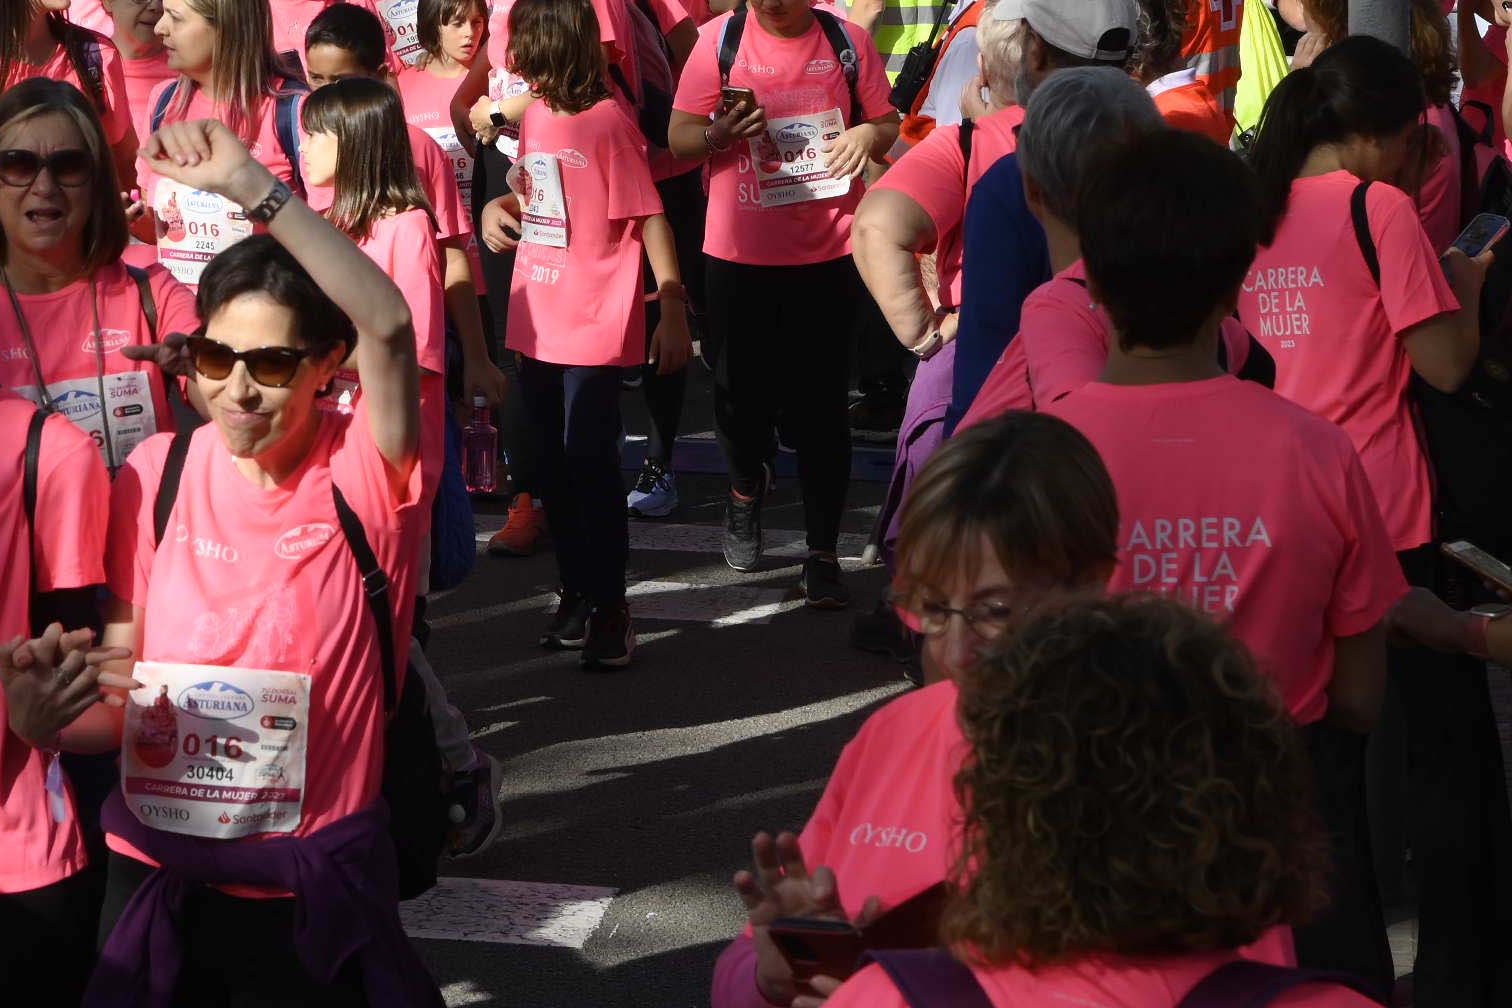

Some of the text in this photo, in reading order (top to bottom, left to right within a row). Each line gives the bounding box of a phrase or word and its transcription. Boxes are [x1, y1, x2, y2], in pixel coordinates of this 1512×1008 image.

[397, 22, 417, 37] 01
[454, 157, 467, 168] 16
[784, 148, 817, 163] 016
[189, 221, 220, 237] 016
[196, 240, 215, 251] 2245
[531, 265, 560, 285] 2019
[1258, 291, 1306, 314] DE LA
[1259, 314, 1310, 337] MUJER
[110, 388, 139, 399] SUMA
[1126, 516, 1273, 551] ARRERA
[1133, 552, 1238, 584] DE LA
[183, 696, 249, 712] ASTURIANA
[260, 694, 297, 705] SUMA
[182, 733, 244, 759] 016
[187, 765, 235, 781] 30404
[144, 783, 188, 796] CARRERA
[190, 788, 204, 797] DE
[206, 788, 220, 798] LA
[222, 789, 258, 800] MUJER
[140, 804, 190, 821] OYSHO
